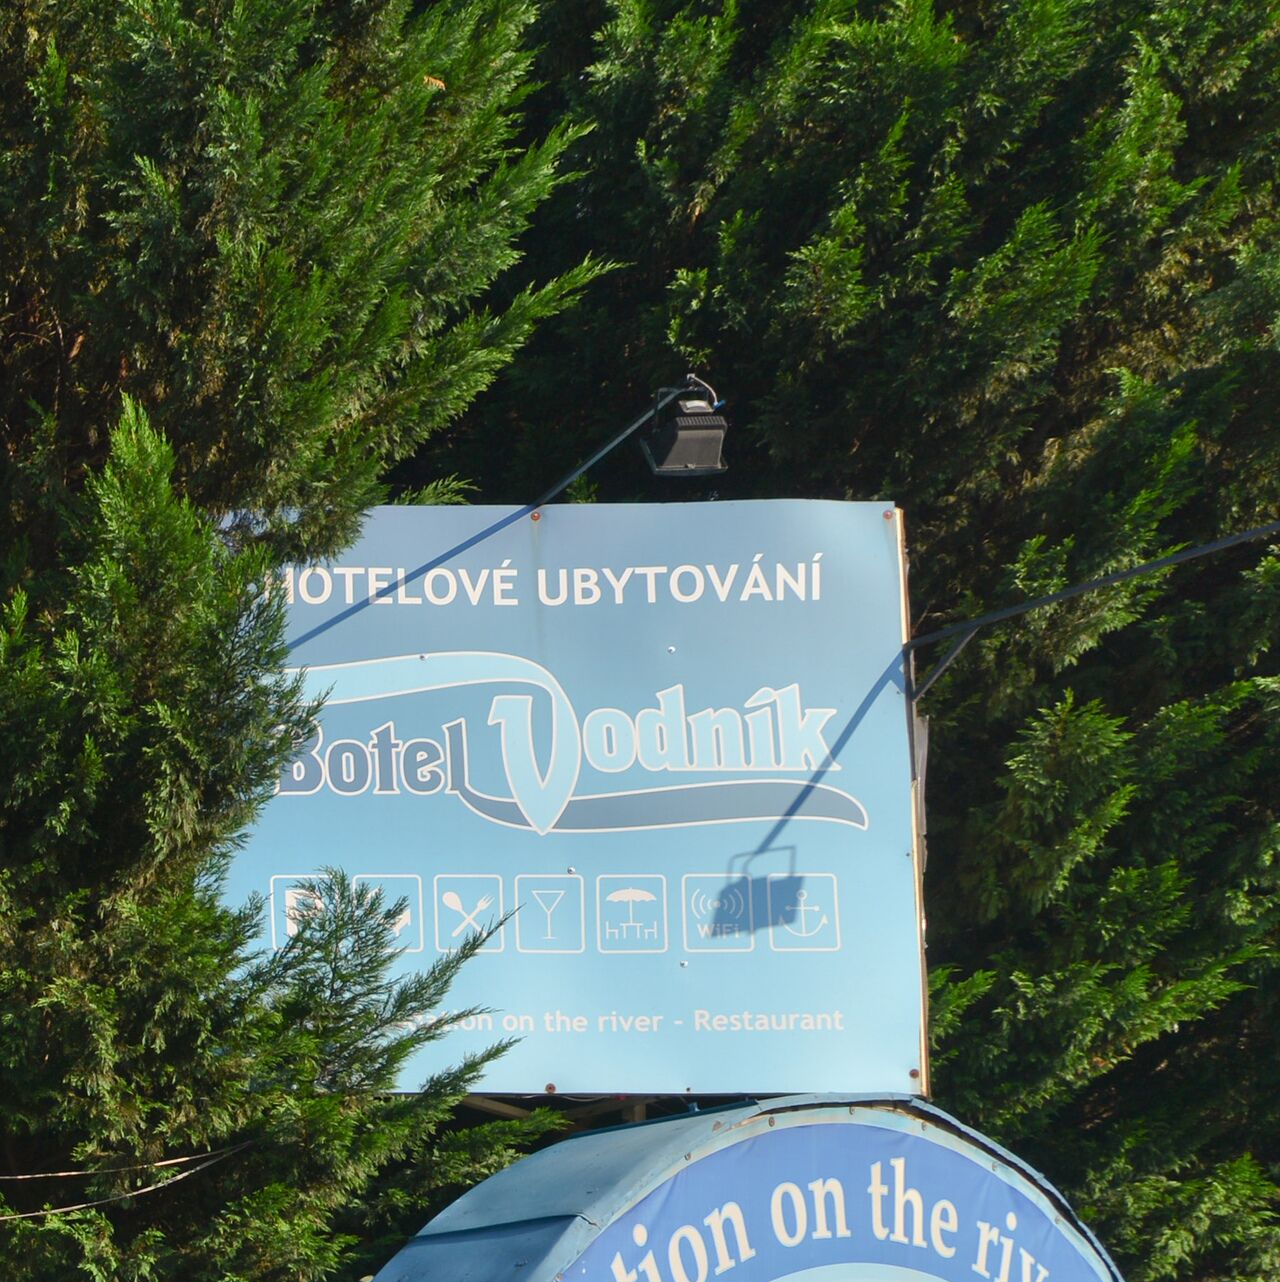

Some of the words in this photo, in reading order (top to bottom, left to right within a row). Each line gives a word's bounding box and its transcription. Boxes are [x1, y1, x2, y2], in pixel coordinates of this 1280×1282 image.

[537, 552, 824, 607] UBYTOVÁNÍ
[273, 717, 466, 797] Botel
[487, 684, 842, 836] Vodník
[502, 1013, 534, 1032] on
[544, 1009, 587, 1032] the
[598, 1010, 663, 1032] river
[694, 1009, 844, 1032] Restaurant
[770, 1176, 852, 1248] on
[867, 1156, 959, 1259] the
